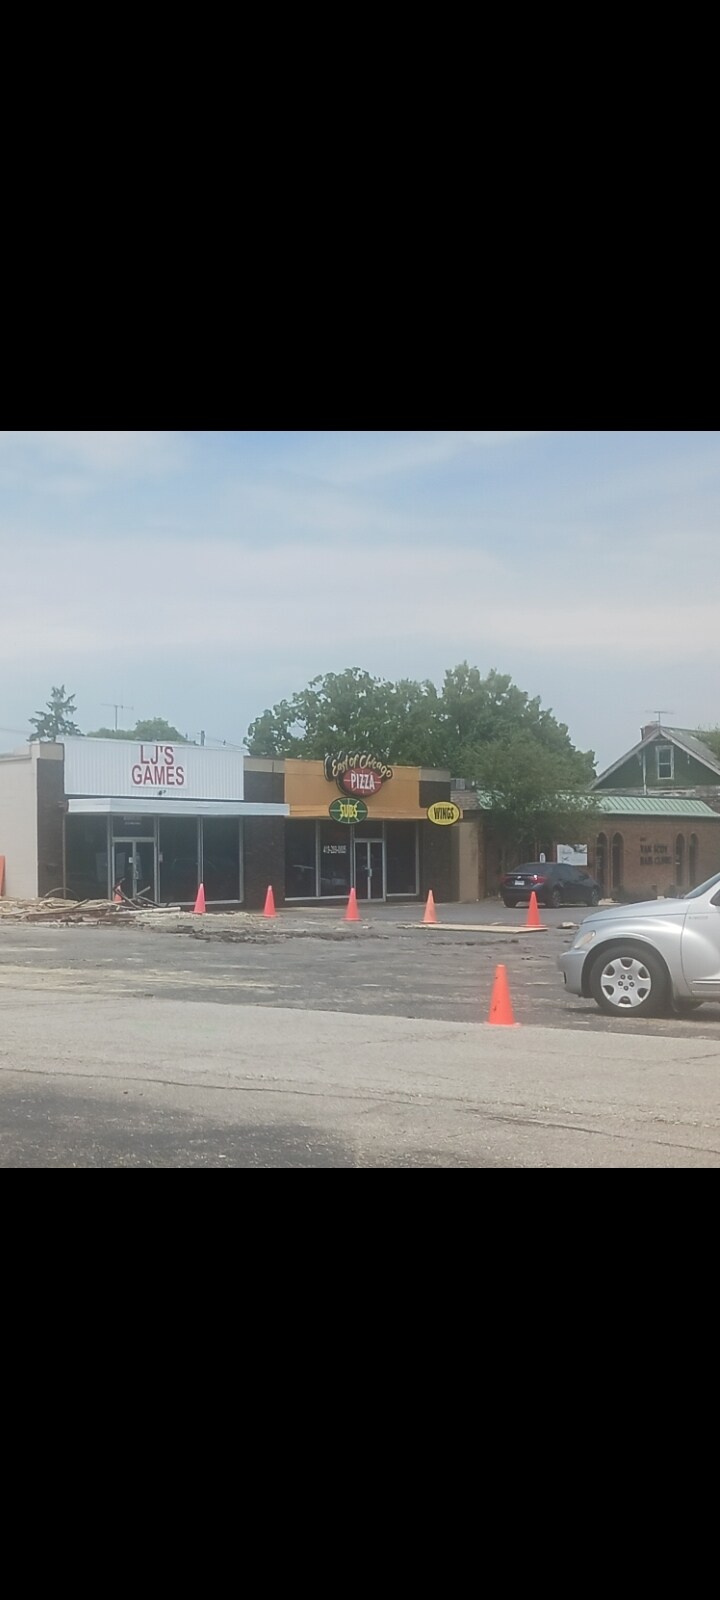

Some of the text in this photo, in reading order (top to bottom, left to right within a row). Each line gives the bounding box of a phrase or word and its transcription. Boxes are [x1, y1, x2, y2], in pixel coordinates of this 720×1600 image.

[140, 745, 174, 765] LJ'S
[332, 754, 392, 778] East of Chicago
[131, 765, 185, 786] GAMES
[350, 773, 375, 790] PIZZA
[340, 804, 358, 818] SUBS
[434, 807, 454, 820] WINGS
